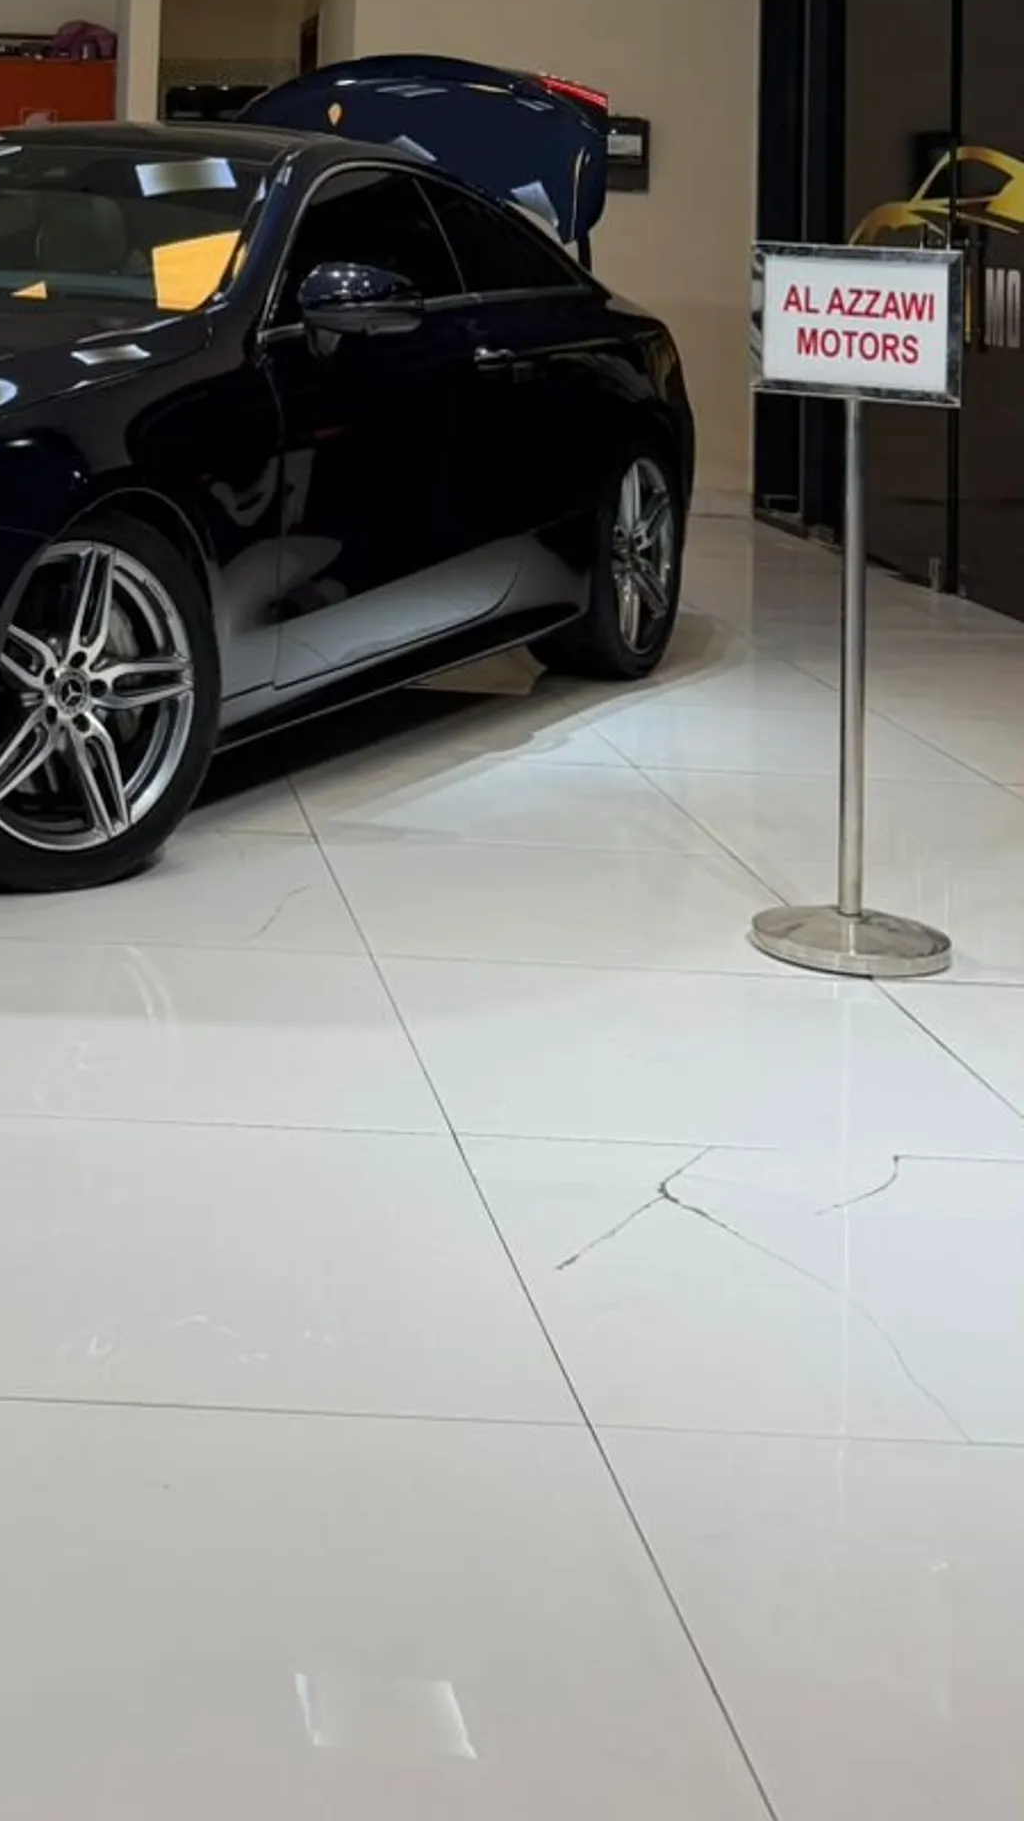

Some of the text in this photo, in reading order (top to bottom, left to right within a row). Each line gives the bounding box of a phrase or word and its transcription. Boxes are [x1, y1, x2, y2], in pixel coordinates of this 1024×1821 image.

[783, 284, 934, 322] AL AZZAWI
[797, 327, 919, 364] MOTORS
